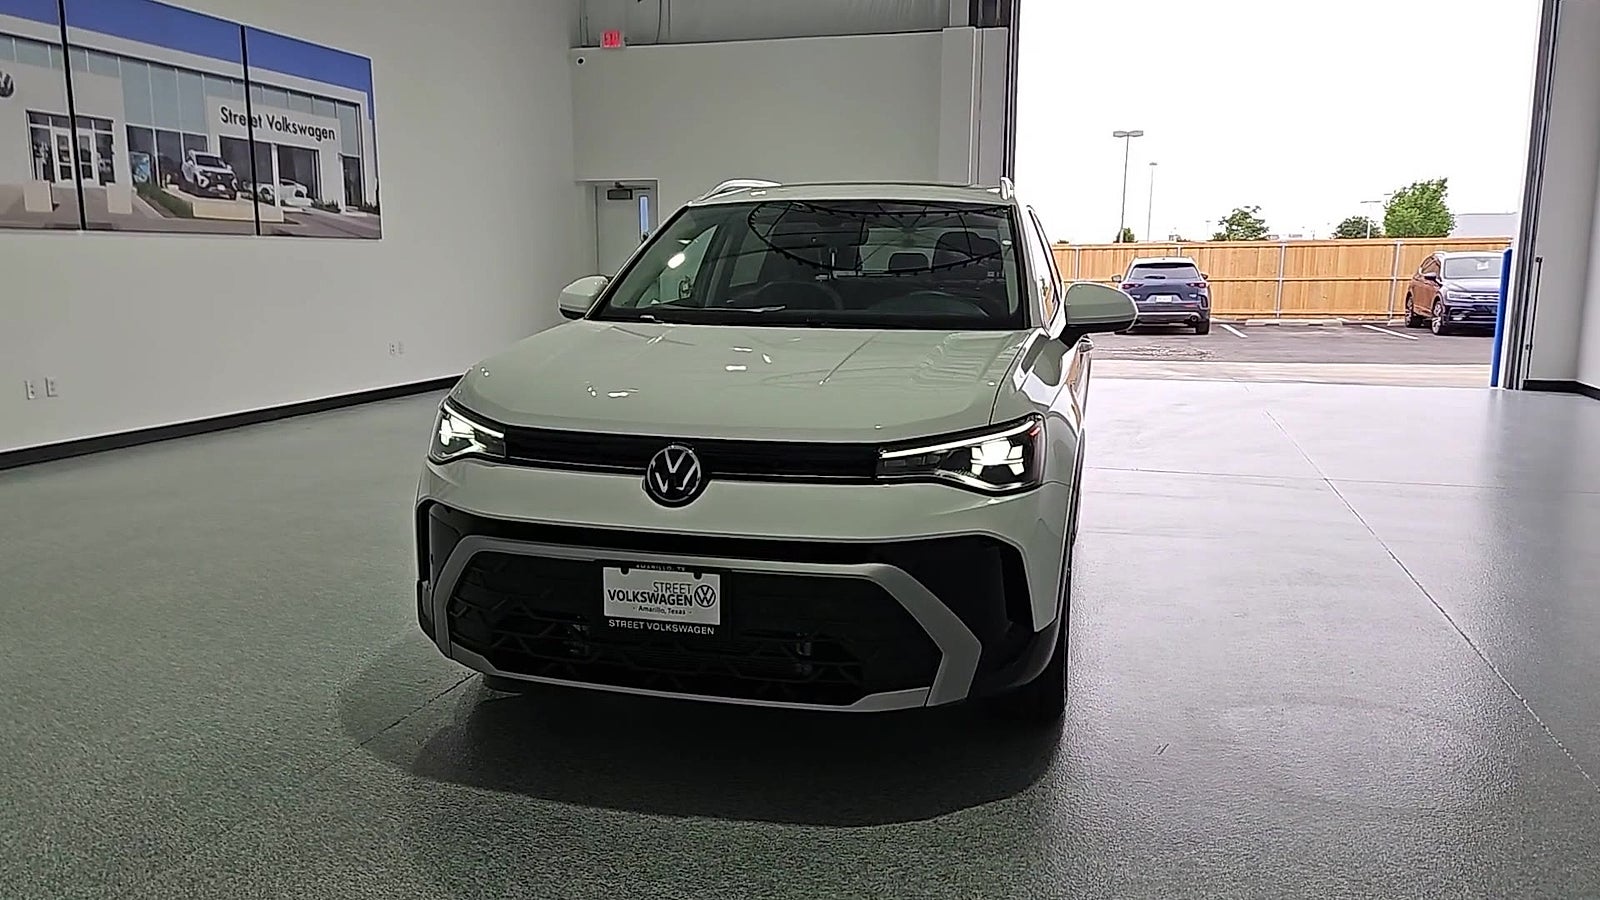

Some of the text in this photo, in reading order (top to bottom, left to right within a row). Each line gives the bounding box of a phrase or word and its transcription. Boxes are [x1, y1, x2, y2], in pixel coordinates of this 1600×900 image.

[220, 106, 336, 142] Street Volkswagen
[652, 581, 693, 595] STREET
[607, 589, 693, 607] VOLKSWAGEN
[667, 607, 686, 615] Texas
[608, 619, 715, 635] STREET VOLKSWAGEN
